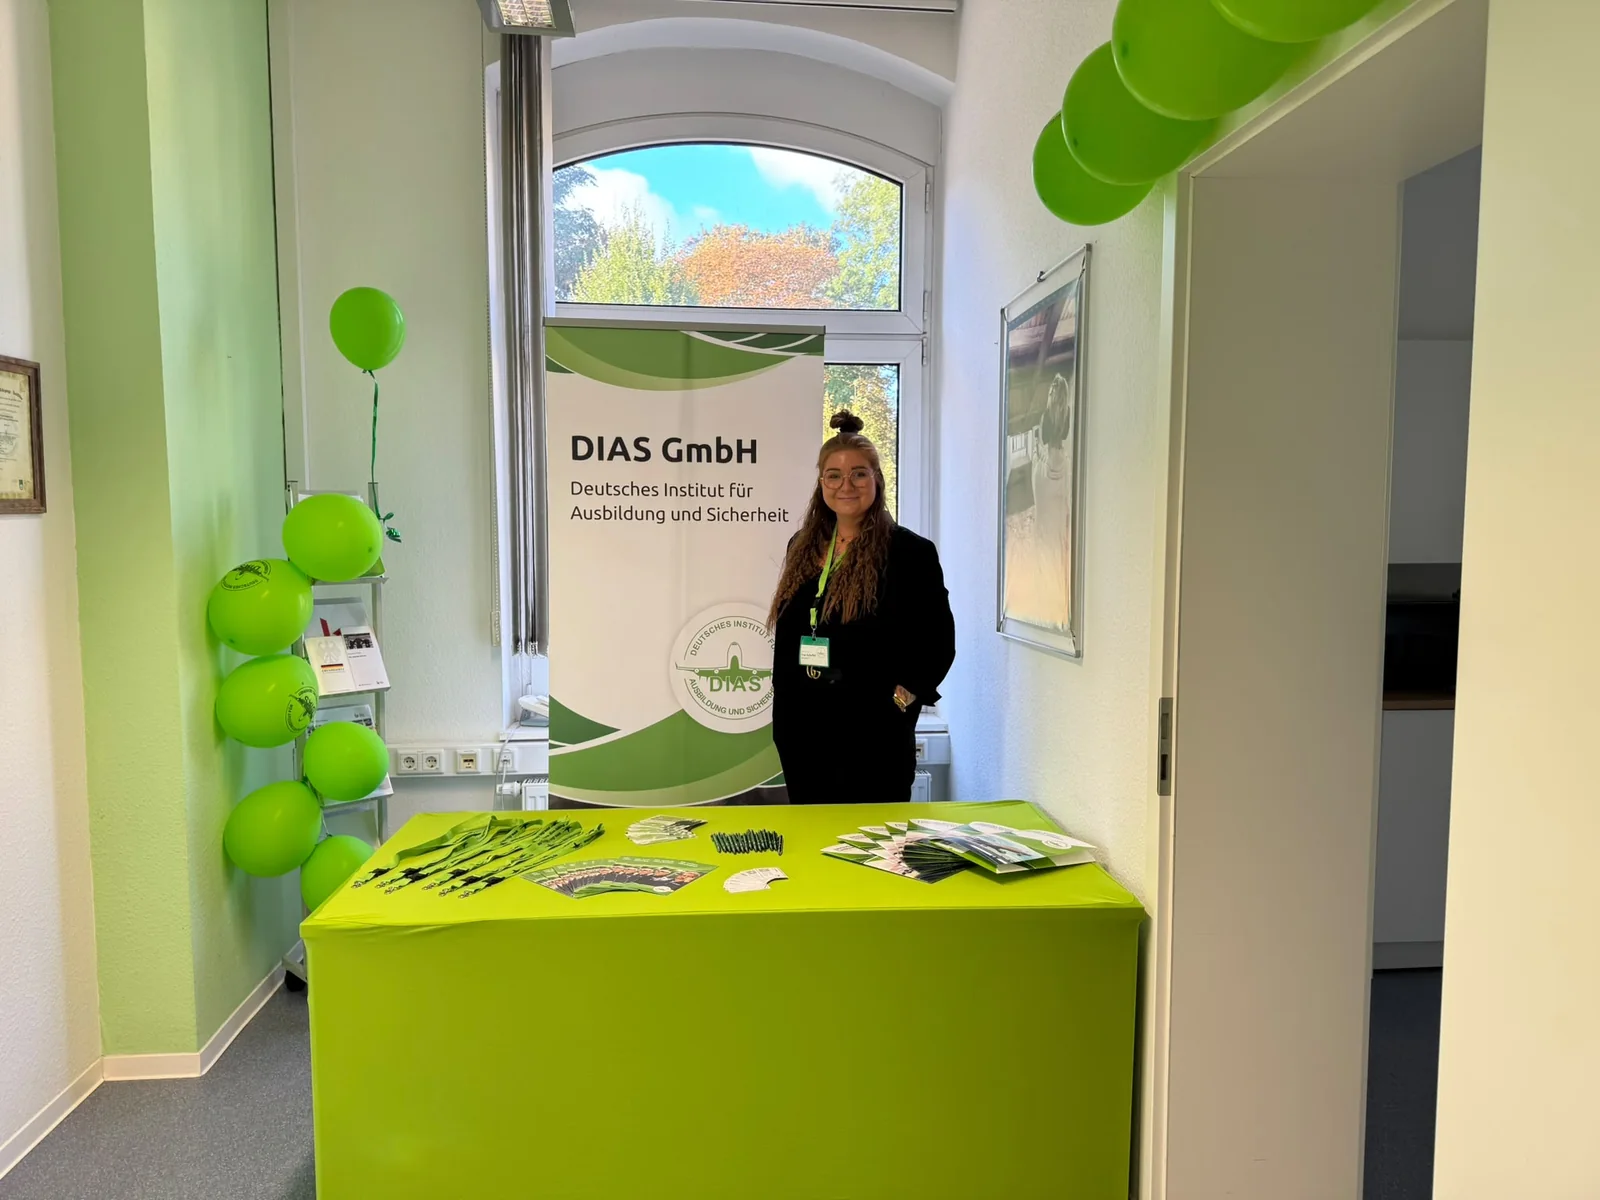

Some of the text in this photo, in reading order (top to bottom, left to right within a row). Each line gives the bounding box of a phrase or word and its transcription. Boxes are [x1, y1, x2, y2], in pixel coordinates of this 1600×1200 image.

[571, 435, 757, 464] DIAS GmbH
[571, 481, 753, 498] Deutsches Institut für
[570, 505, 789, 524] Ausbildung und Sicherheit
[690, 620, 770, 656] DEUTSCHES INSTITUT
[709, 676, 761, 693] DIAS
[689, 678, 727, 714] AUSBILDUNG
[728, 708, 745, 716] UND
